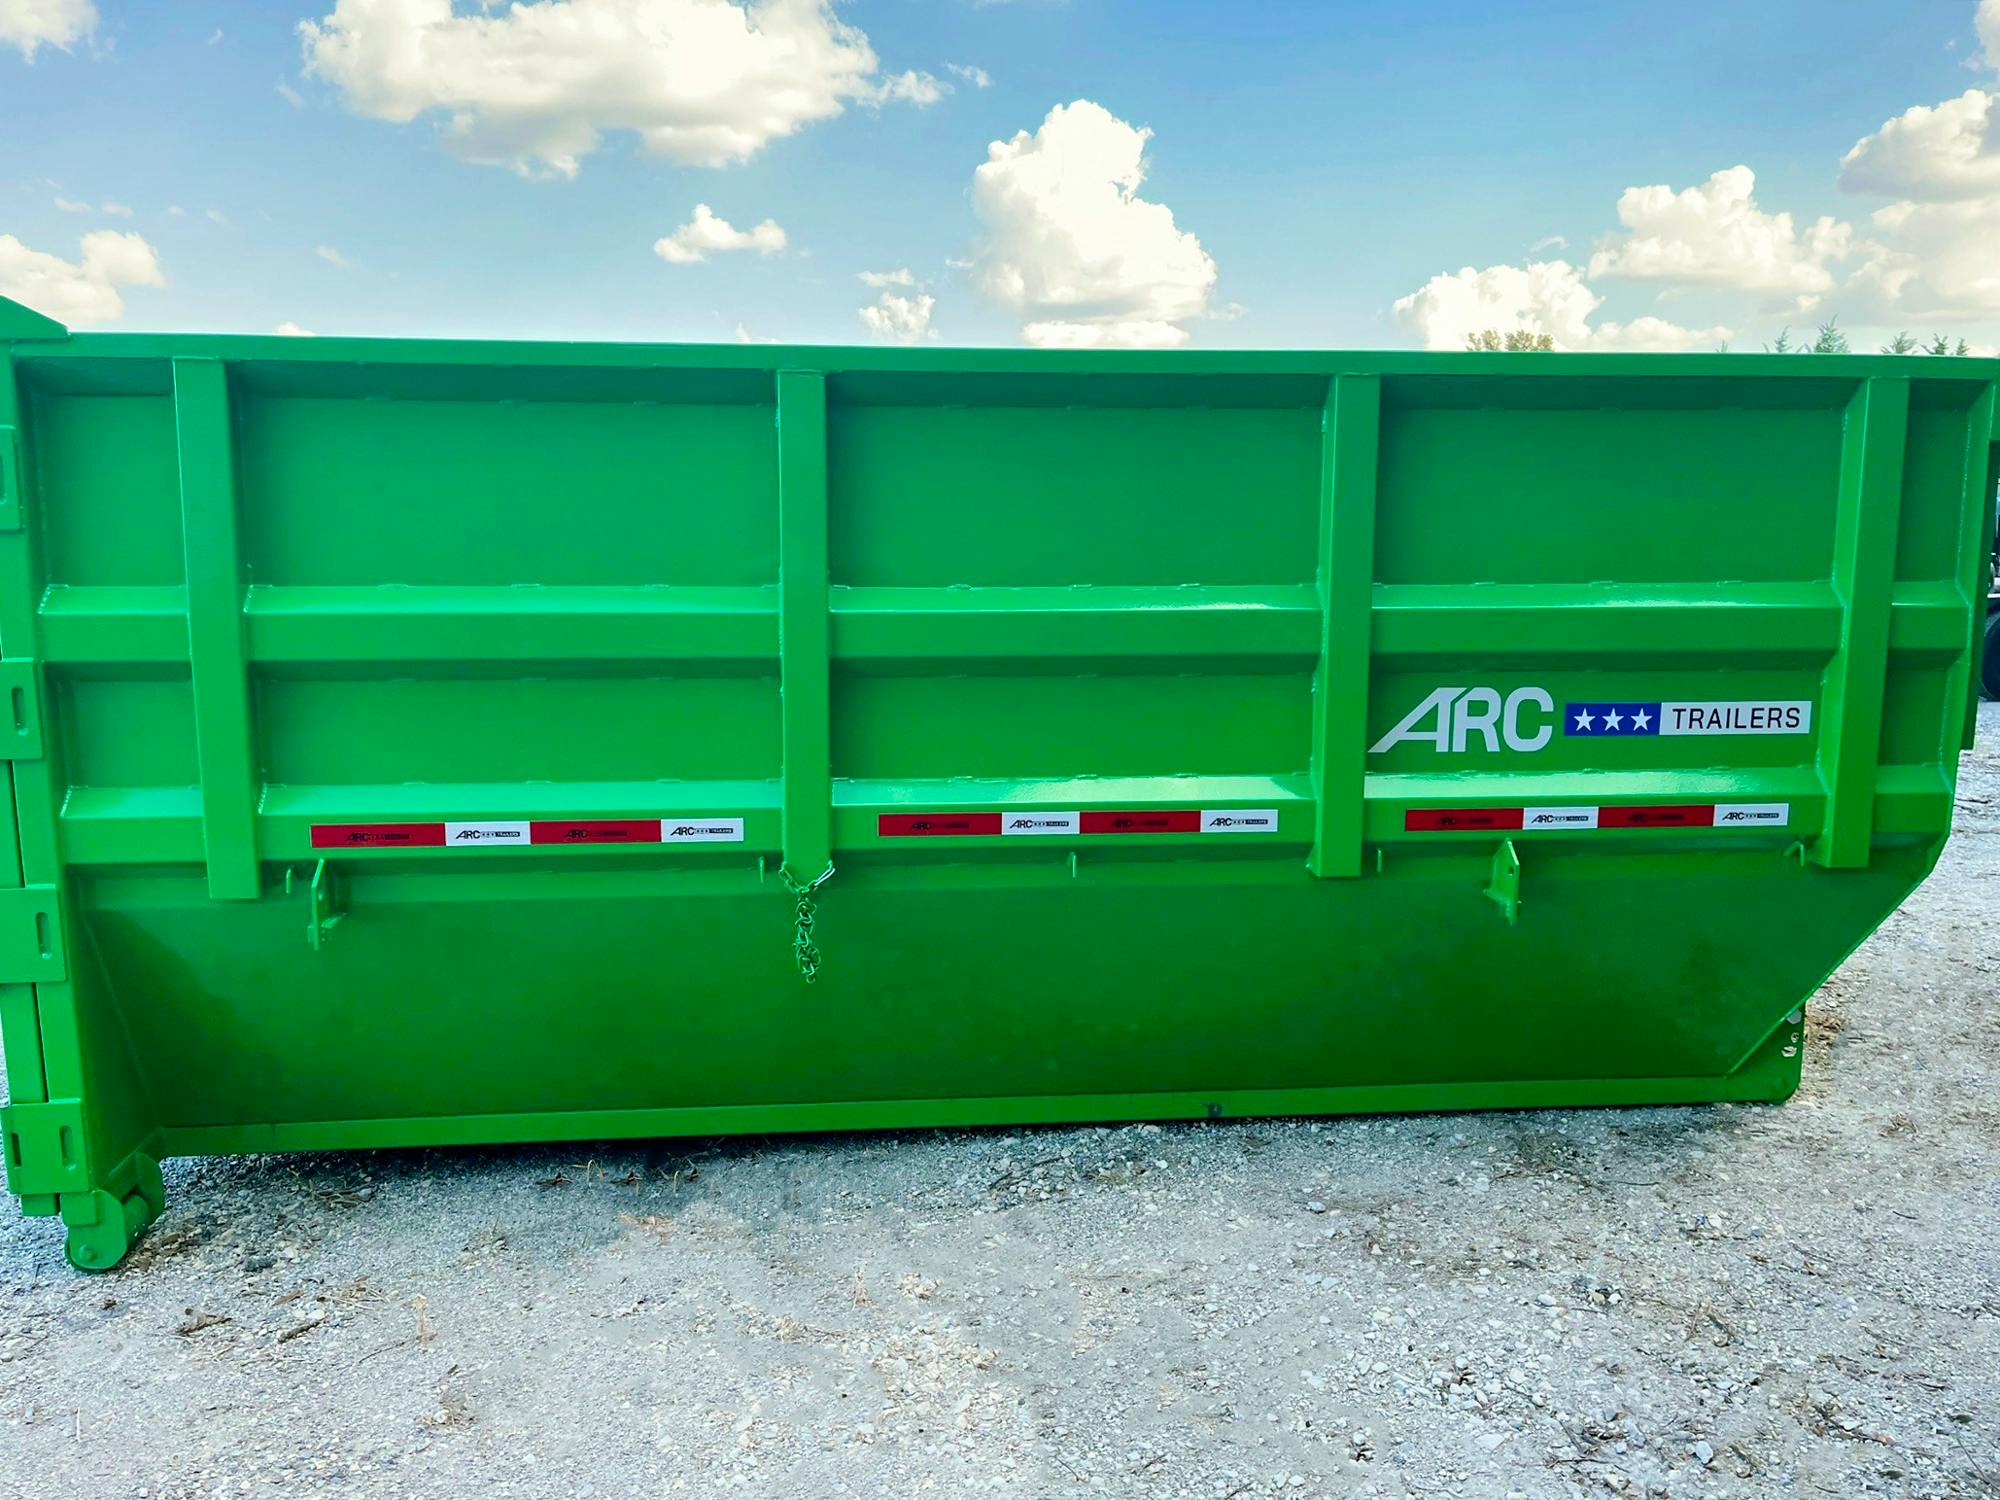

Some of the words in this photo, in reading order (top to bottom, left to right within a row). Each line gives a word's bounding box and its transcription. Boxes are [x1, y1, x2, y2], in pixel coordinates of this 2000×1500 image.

[1367, 686, 1554, 753] ARC
[1672, 706, 1801, 730] TRAILERS
[1531, 814, 1554, 824] ARC
[1722, 812, 1745, 820] ARC
[1010, 820, 1033, 829] ARC
[1209, 818, 1232, 826] ARC
[456, 830, 481, 840] ARC
[564, 829, 588, 838] ARC
[670, 827, 694, 836] ARC
[345, 832, 369, 842] ARC
